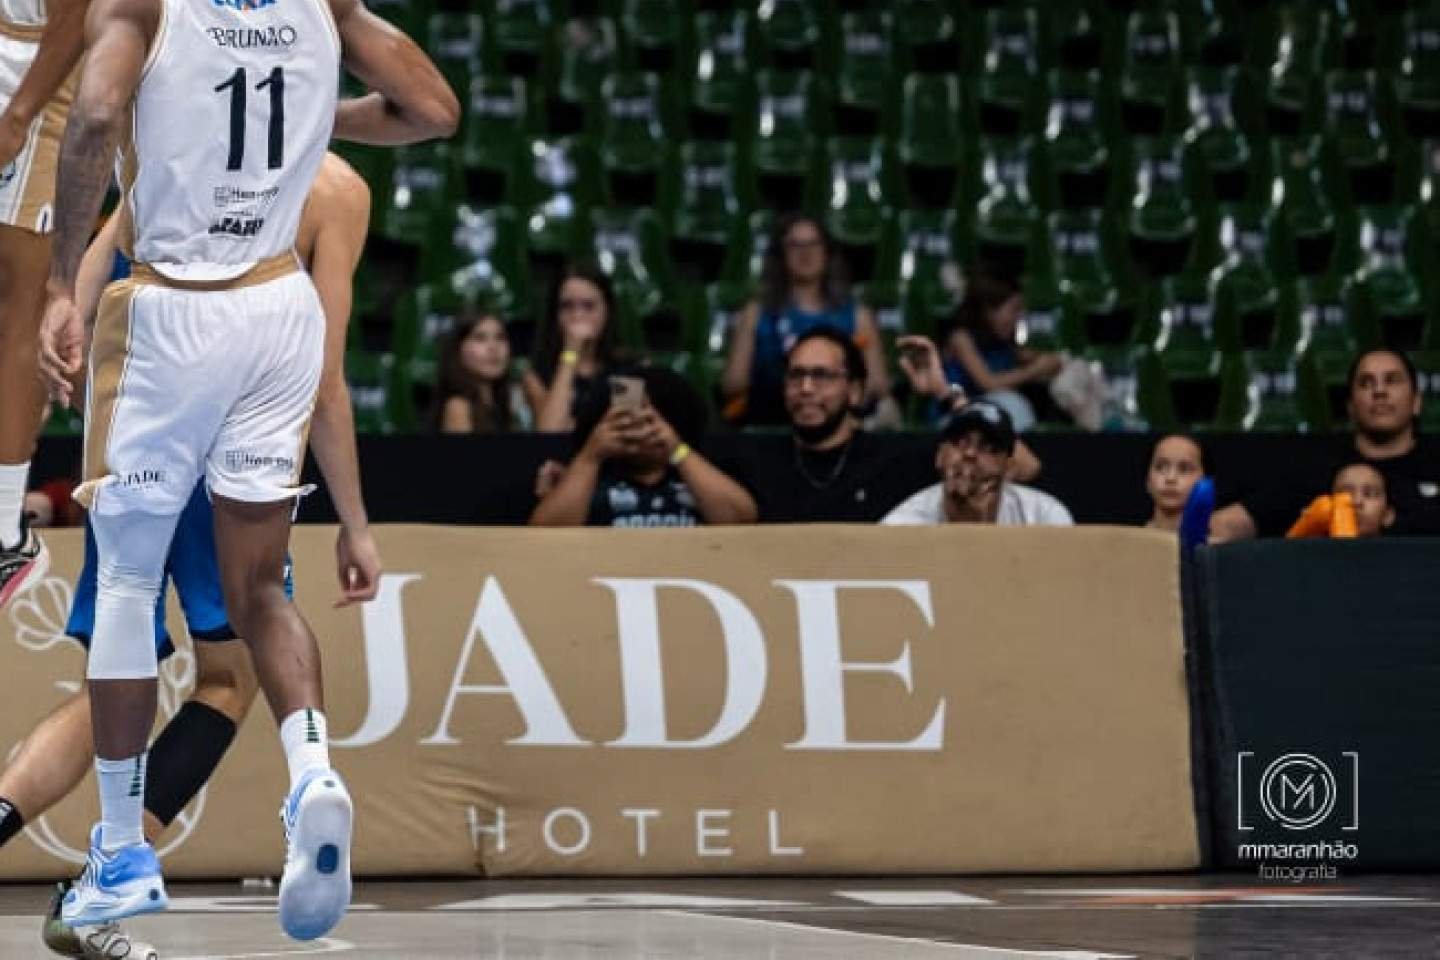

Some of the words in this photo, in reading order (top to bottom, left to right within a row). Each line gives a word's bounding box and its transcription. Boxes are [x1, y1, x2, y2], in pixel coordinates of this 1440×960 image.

[214, 67, 284, 171] 11
[324, 573, 947, 751] JADE
[467, 806, 803, 856] HOTEL
